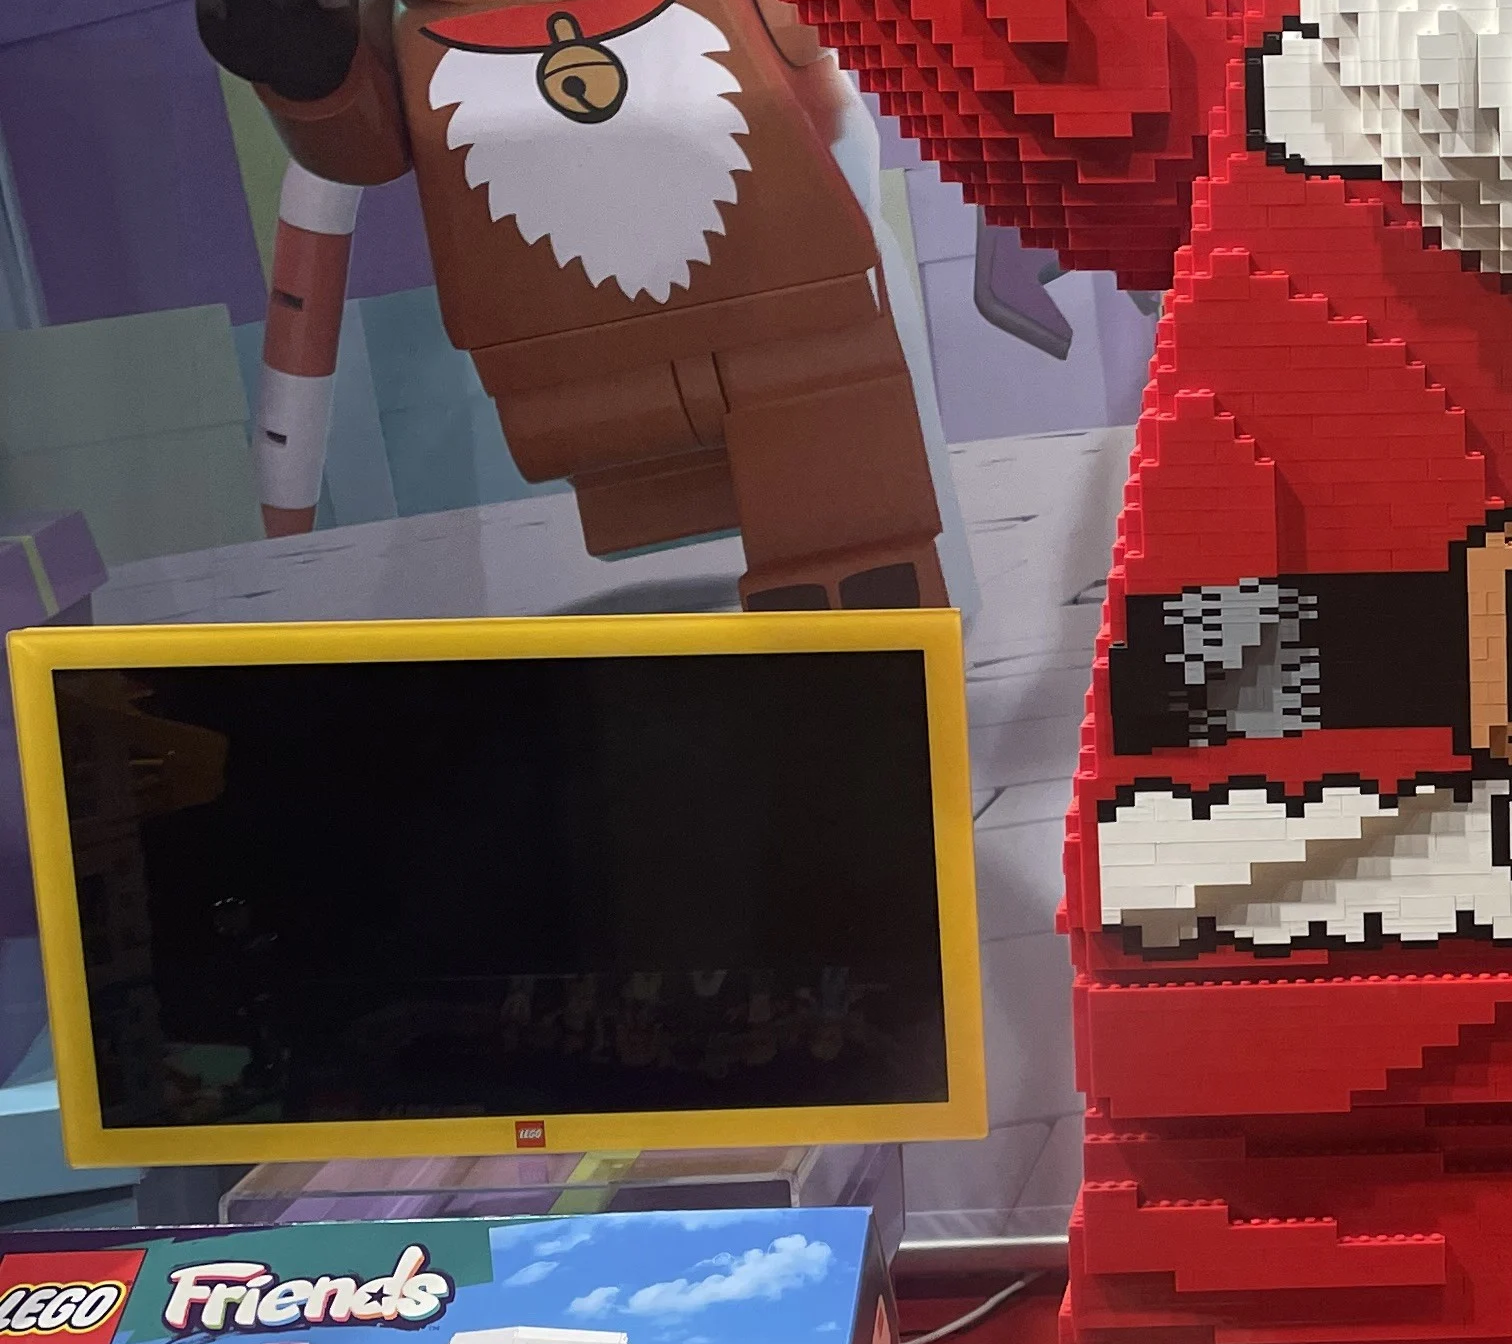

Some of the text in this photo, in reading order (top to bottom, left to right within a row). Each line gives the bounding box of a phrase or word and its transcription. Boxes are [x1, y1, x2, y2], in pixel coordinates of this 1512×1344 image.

[519, 1128, 542, 1139] LEGO
[0, 1284, 121, 1332] LEGO
[164, 1245, 448, 1329] Friends
